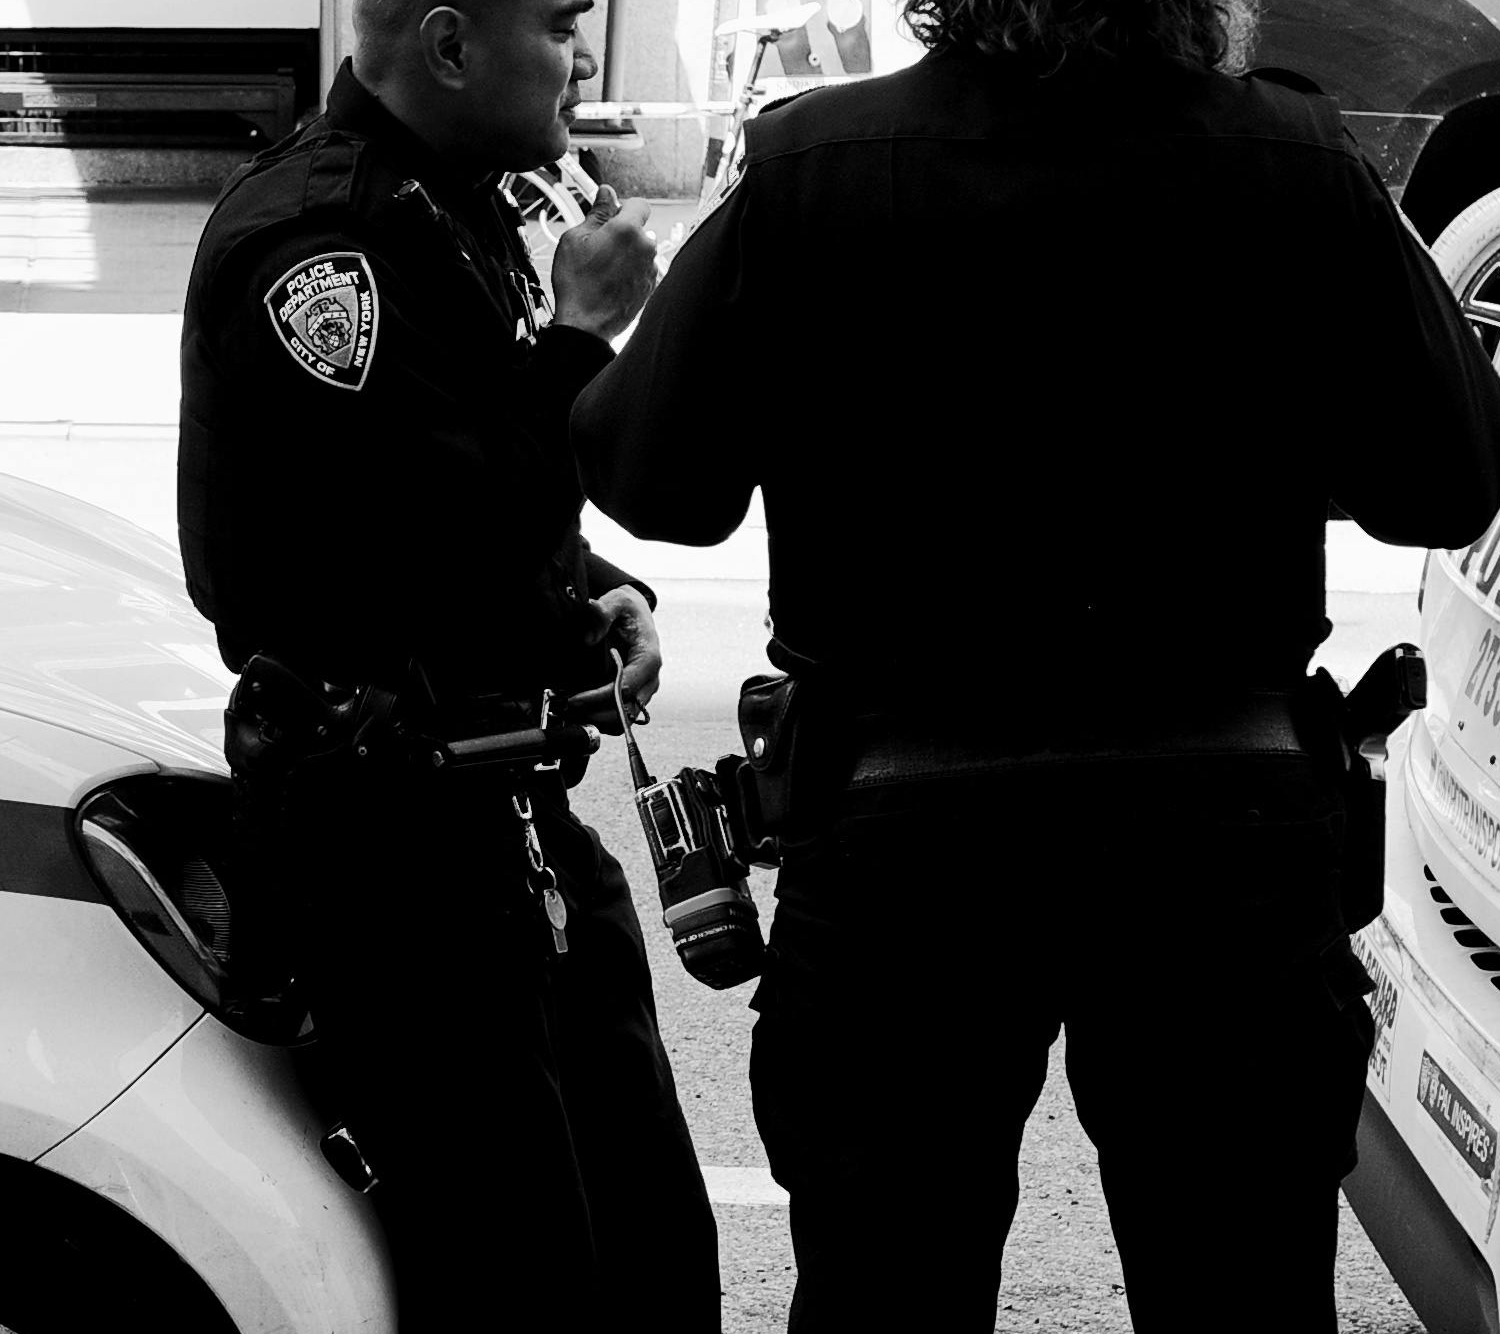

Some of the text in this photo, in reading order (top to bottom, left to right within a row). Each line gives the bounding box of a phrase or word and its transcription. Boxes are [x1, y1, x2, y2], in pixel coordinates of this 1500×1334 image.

[278, 270, 360, 323] DEPARTMENT
[286, 261, 336, 297] POLICE
[353, 289, 372, 368] NEW YORK
[290, 336, 336, 377] CITY OF
[1437, 1083, 1452, 1122] PAL
[1450, 1099, 1490, 1163] INSPIRES
